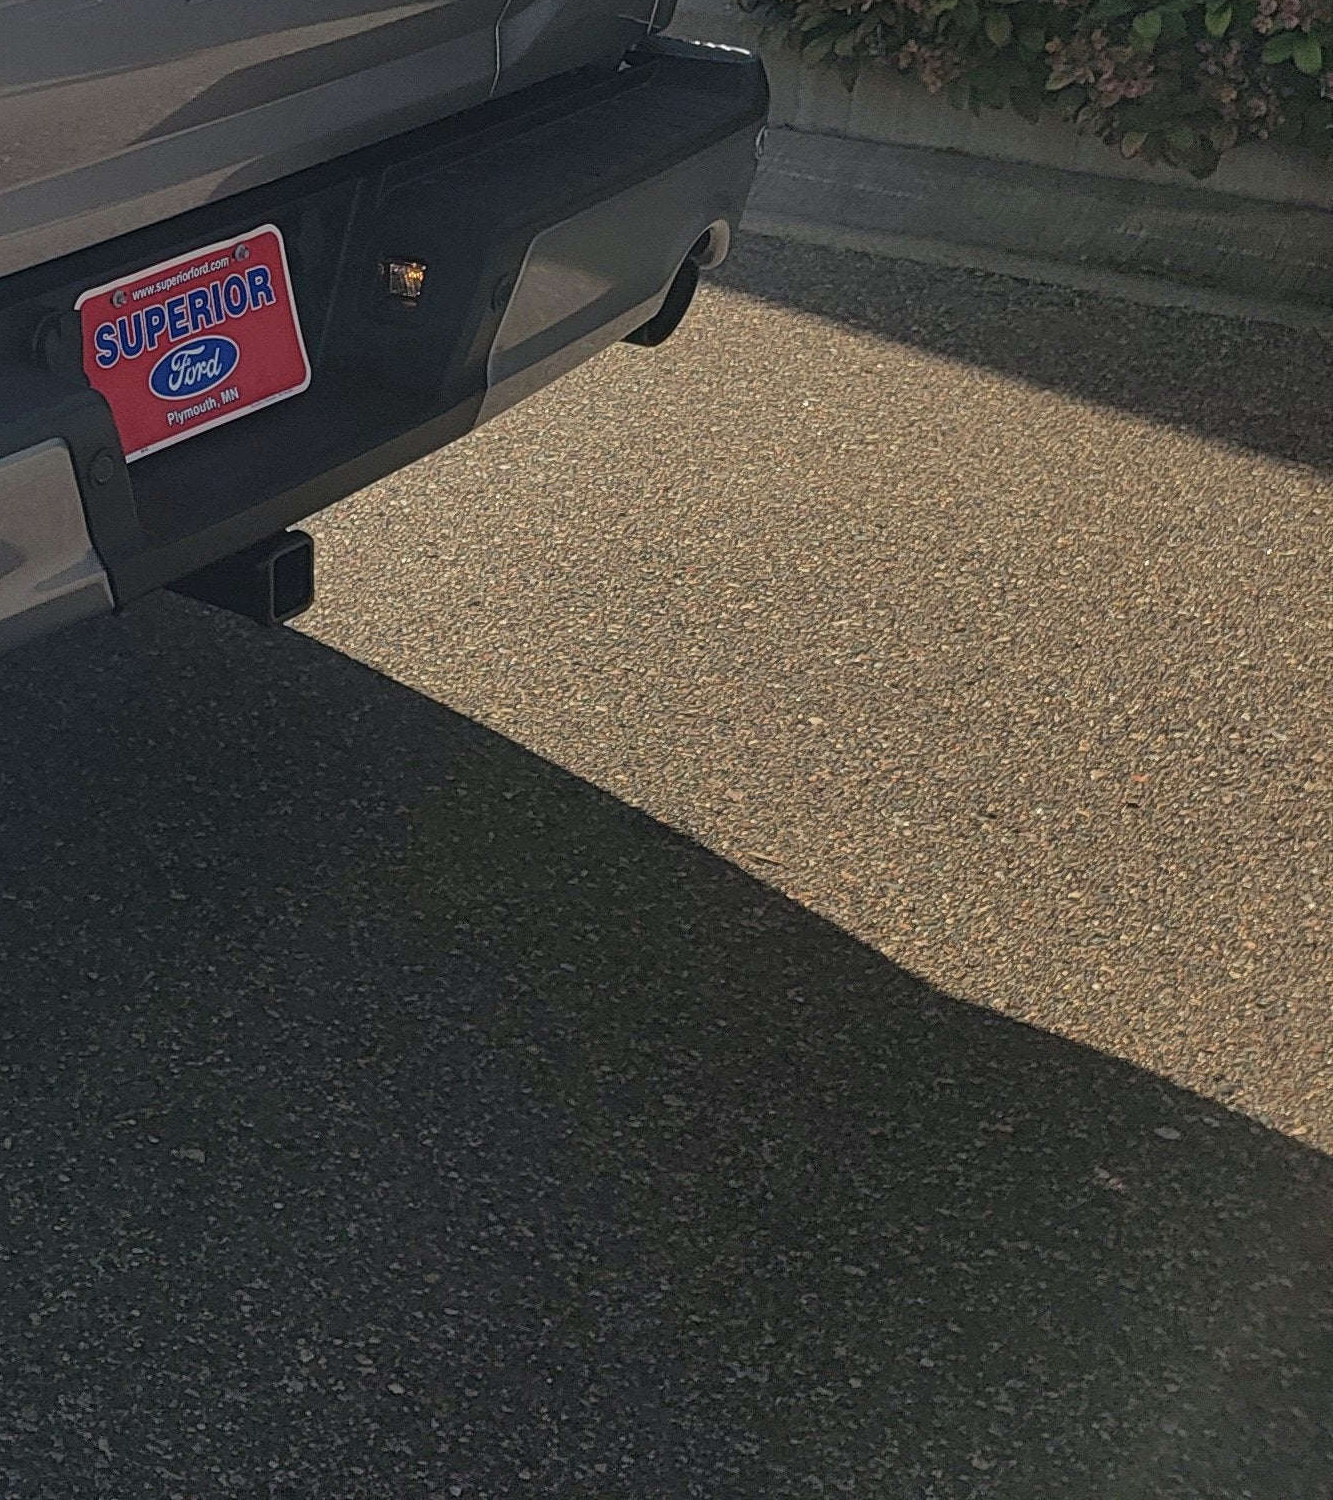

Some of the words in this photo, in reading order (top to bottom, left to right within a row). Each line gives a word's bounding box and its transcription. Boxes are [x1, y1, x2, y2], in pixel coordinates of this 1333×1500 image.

[132, 257, 230, 300] www.superiorford.com
[94, 265, 276, 369] SUPERIOR
[168, 345, 222, 391] Ford
[167, 396, 221, 426] Plymouth,
[221, 386, 240, 405] MN
